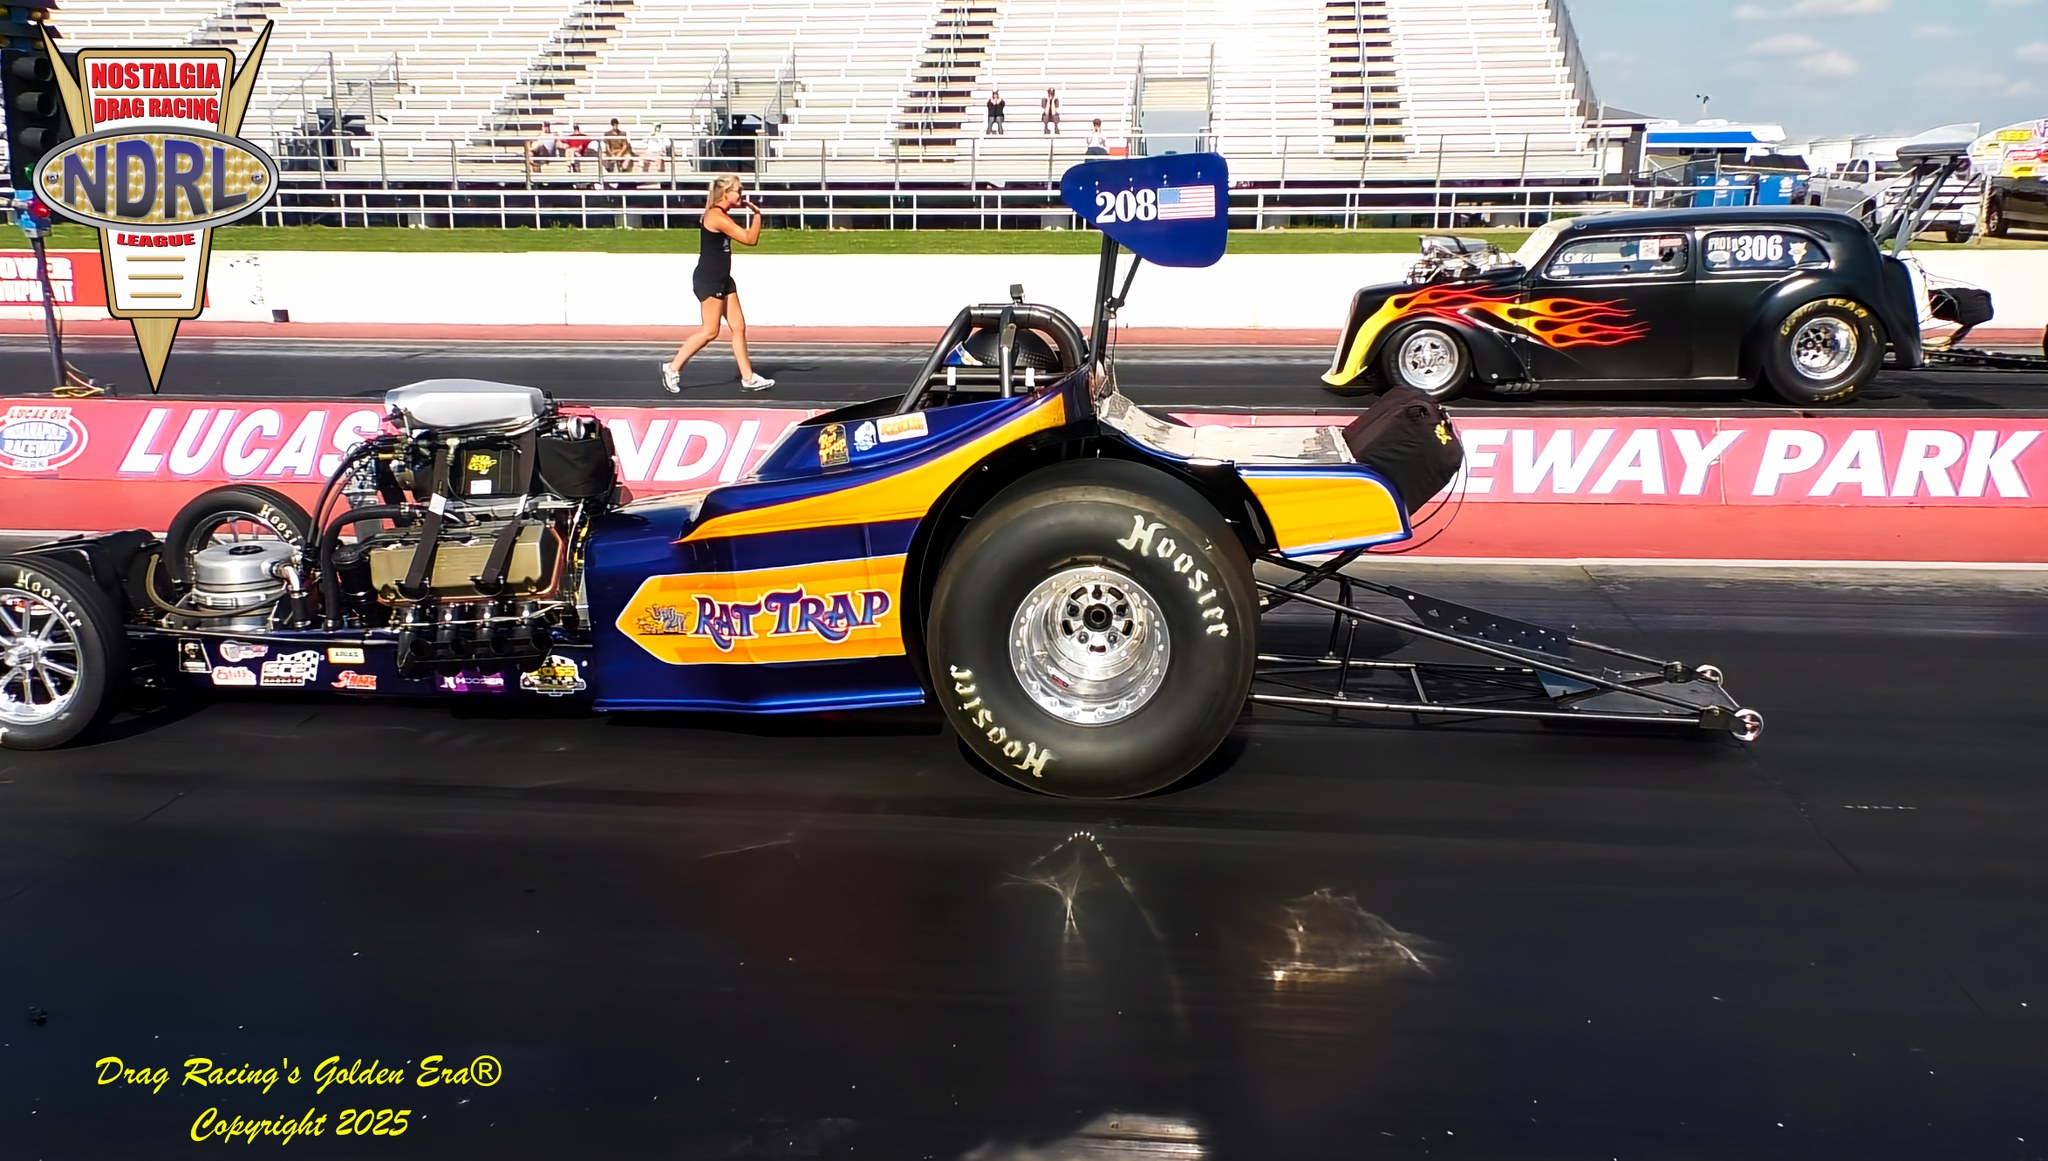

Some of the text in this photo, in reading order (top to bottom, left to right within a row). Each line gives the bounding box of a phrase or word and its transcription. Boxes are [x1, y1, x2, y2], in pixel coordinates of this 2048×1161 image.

[1095, 188, 1157, 224] 208
[1735, 234, 1783, 262] 306
[118, 407, 381, 478] LUCAS
[1442, 428, 1745, 495] EWAY
[1751, 429, 2045, 498] PARK
[14, 569, 82, 628] Hoosier
[1116, 514, 1230, 638] Hoosier
[689, 583, 892, 651] RAT TRAP
[949, 664, 1059, 779] Hoosier
